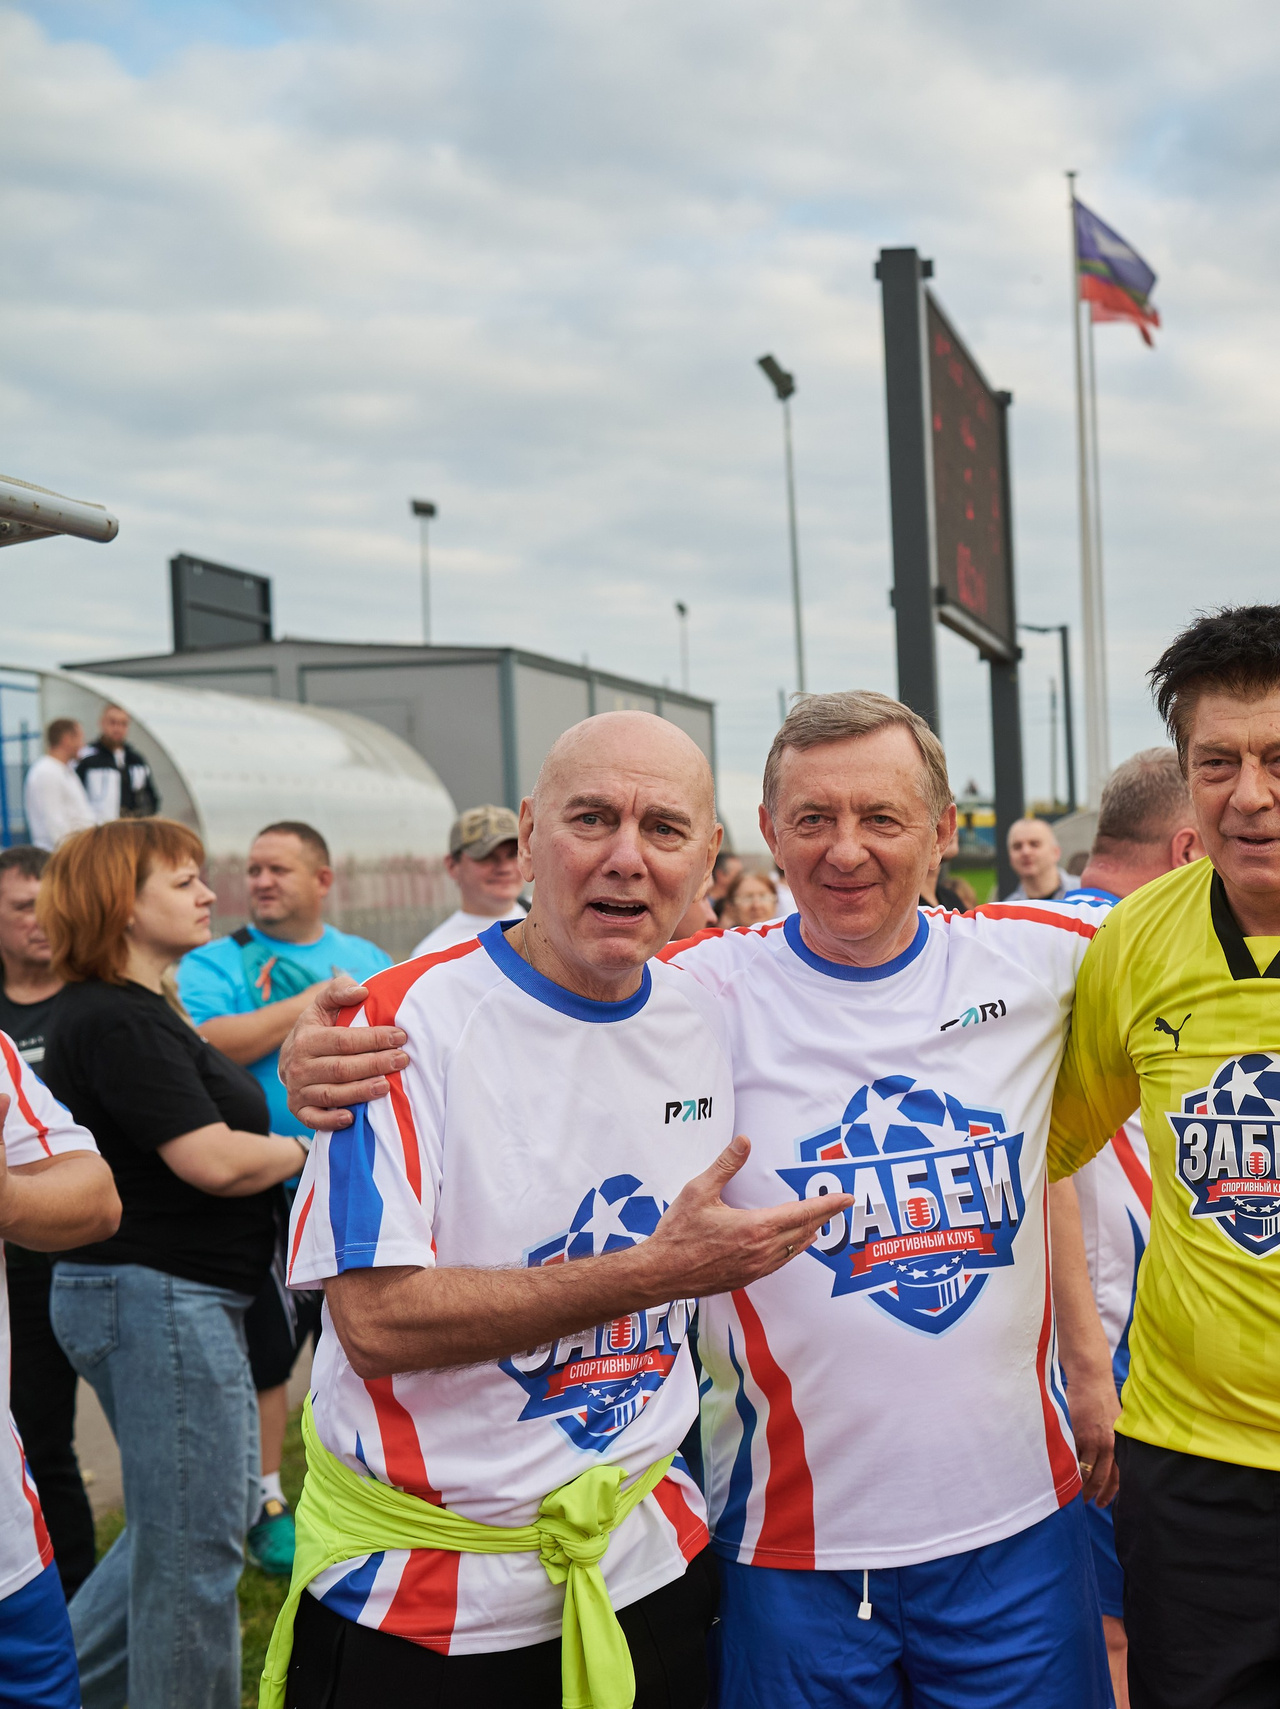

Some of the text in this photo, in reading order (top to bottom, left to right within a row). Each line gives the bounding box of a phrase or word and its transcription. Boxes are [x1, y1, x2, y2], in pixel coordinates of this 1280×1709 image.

[664, 1096, 713, 1124] PARI
[804, 1139, 1019, 1253] ЗАБЕЙ
[1221, 1181, 1271, 1193] СПОРТИВНЫЙ
[872, 1230, 975, 1257] СПОРТИВНЫЙ КЛУБ
[569, 1354, 639, 1379] СПОРТИВНЫЙ
